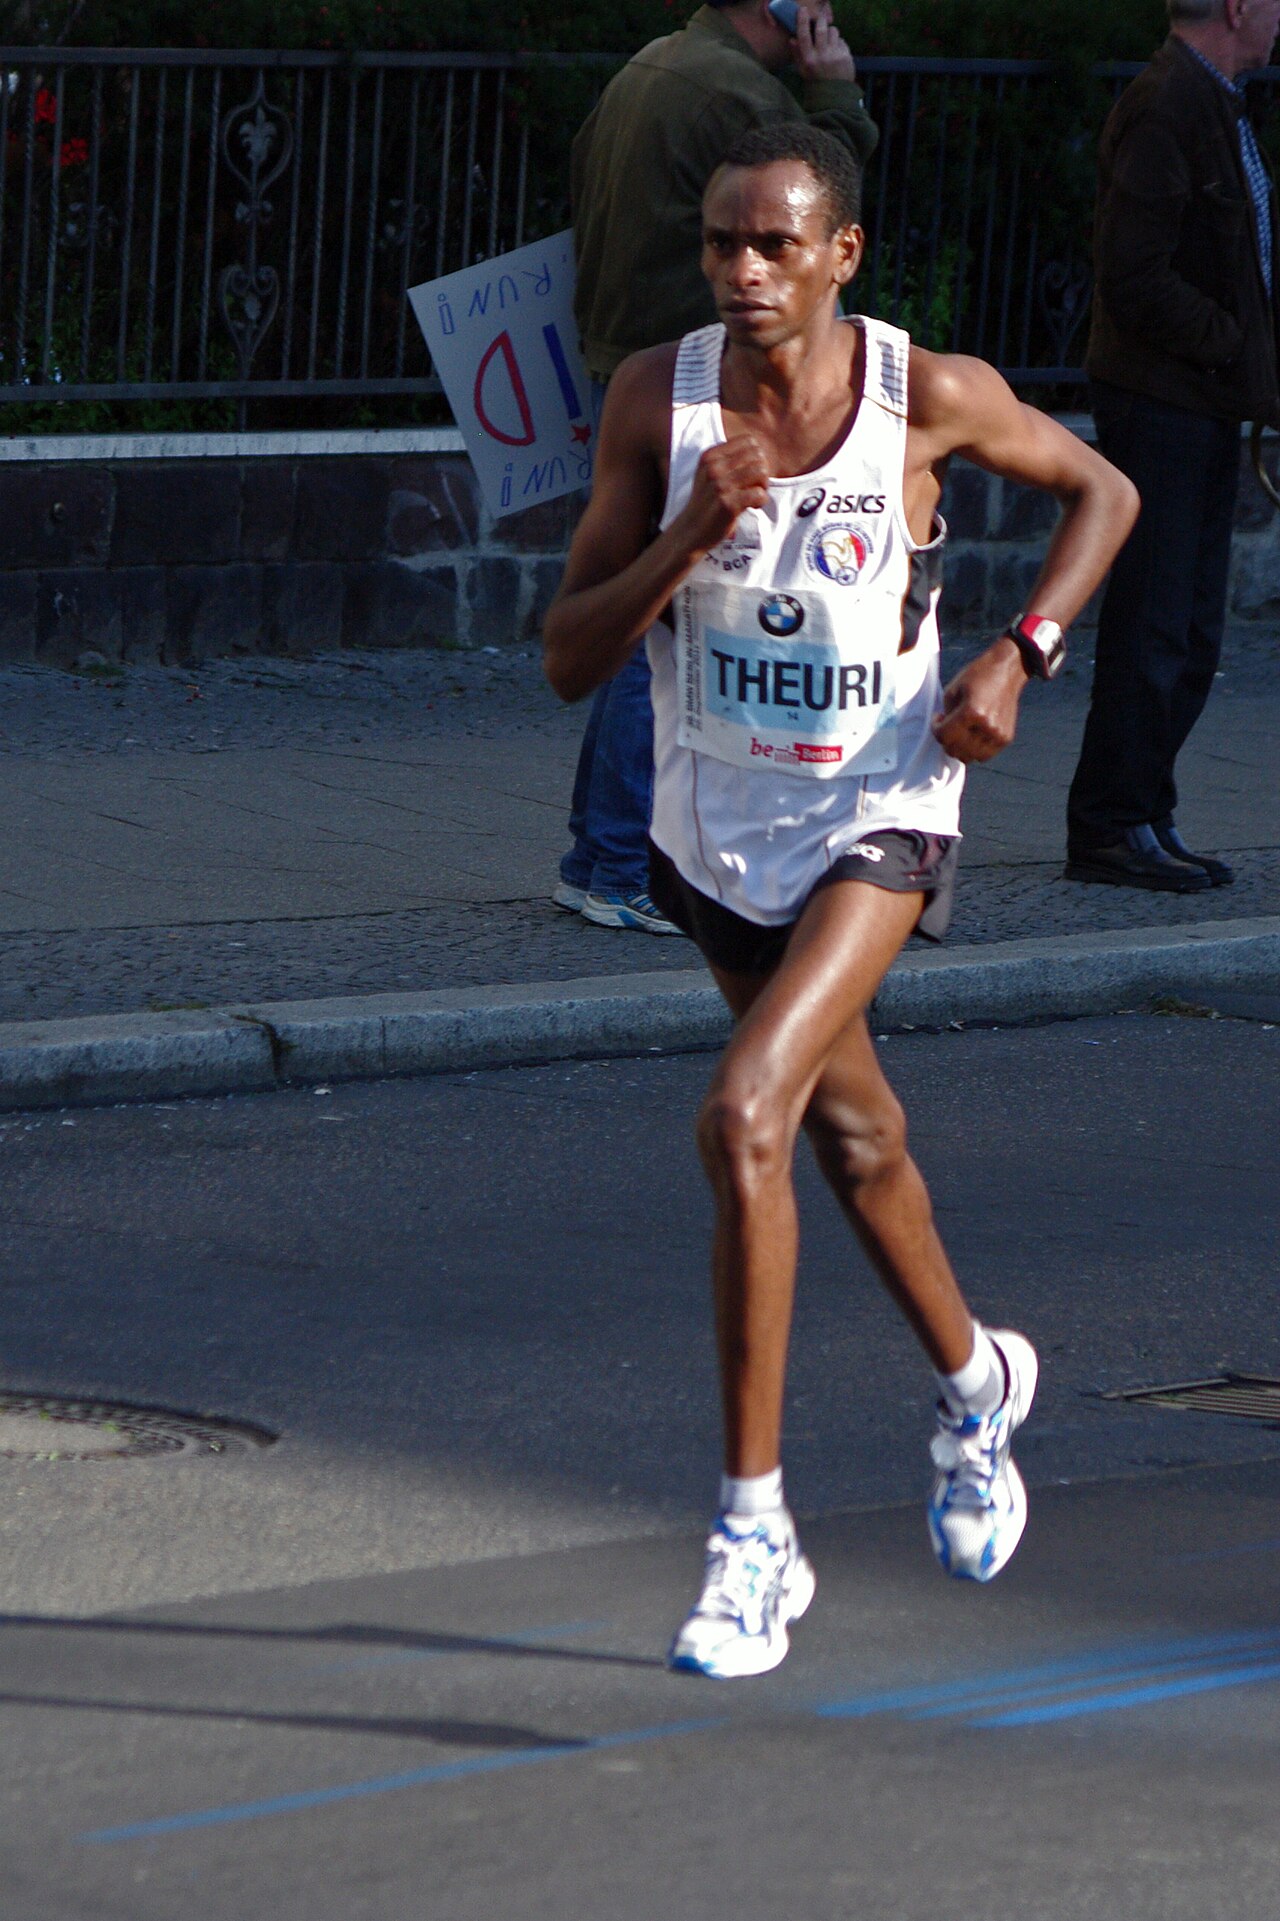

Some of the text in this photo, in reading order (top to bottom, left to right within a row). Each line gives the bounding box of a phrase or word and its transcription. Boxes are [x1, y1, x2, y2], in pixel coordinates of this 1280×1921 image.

[826, 493, 887, 514] asics
[711, 649, 882, 711] THEURI
[750, 737, 774, 757] be
